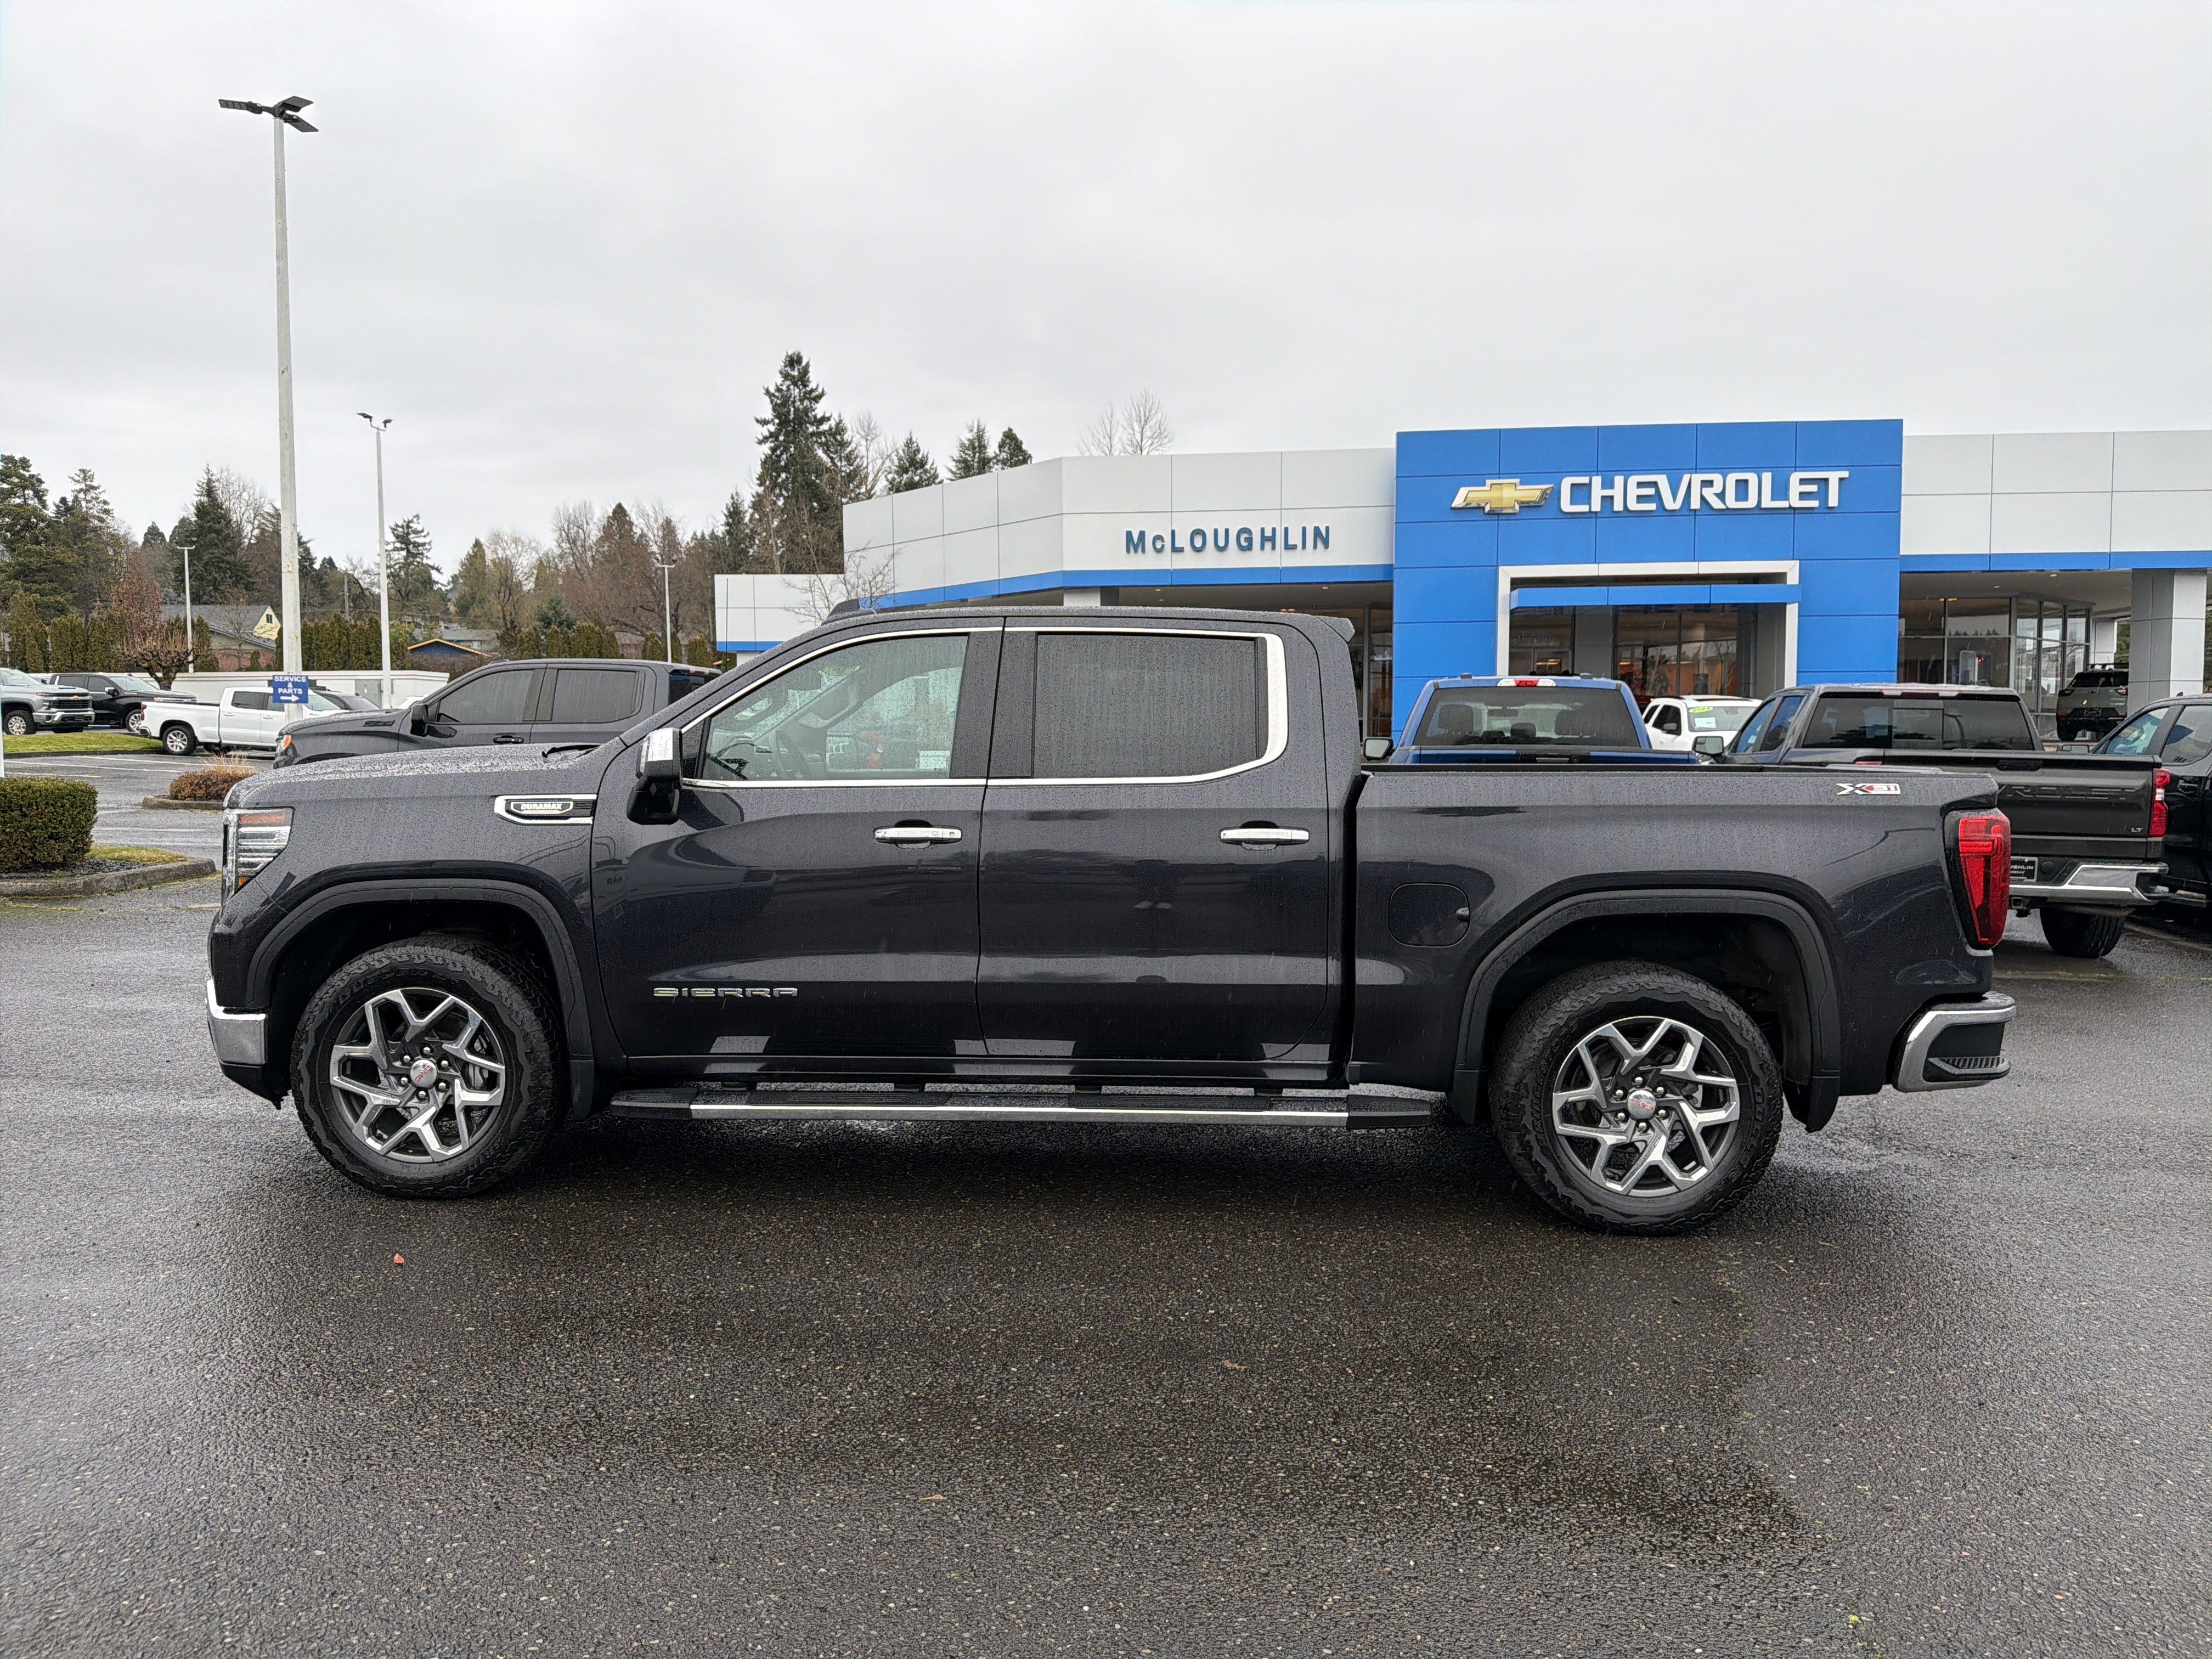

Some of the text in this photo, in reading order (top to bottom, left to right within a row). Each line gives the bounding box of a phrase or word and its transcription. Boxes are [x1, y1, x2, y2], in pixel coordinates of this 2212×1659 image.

[1560, 471, 1849, 513] CHEVROLET
[1125, 526, 1330, 554] McLOUGHLIN
[653, 988, 798, 997] SIERRA
[414, 1064, 431, 1083] GMC
[1629, 1097, 1654, 1111] GMC
